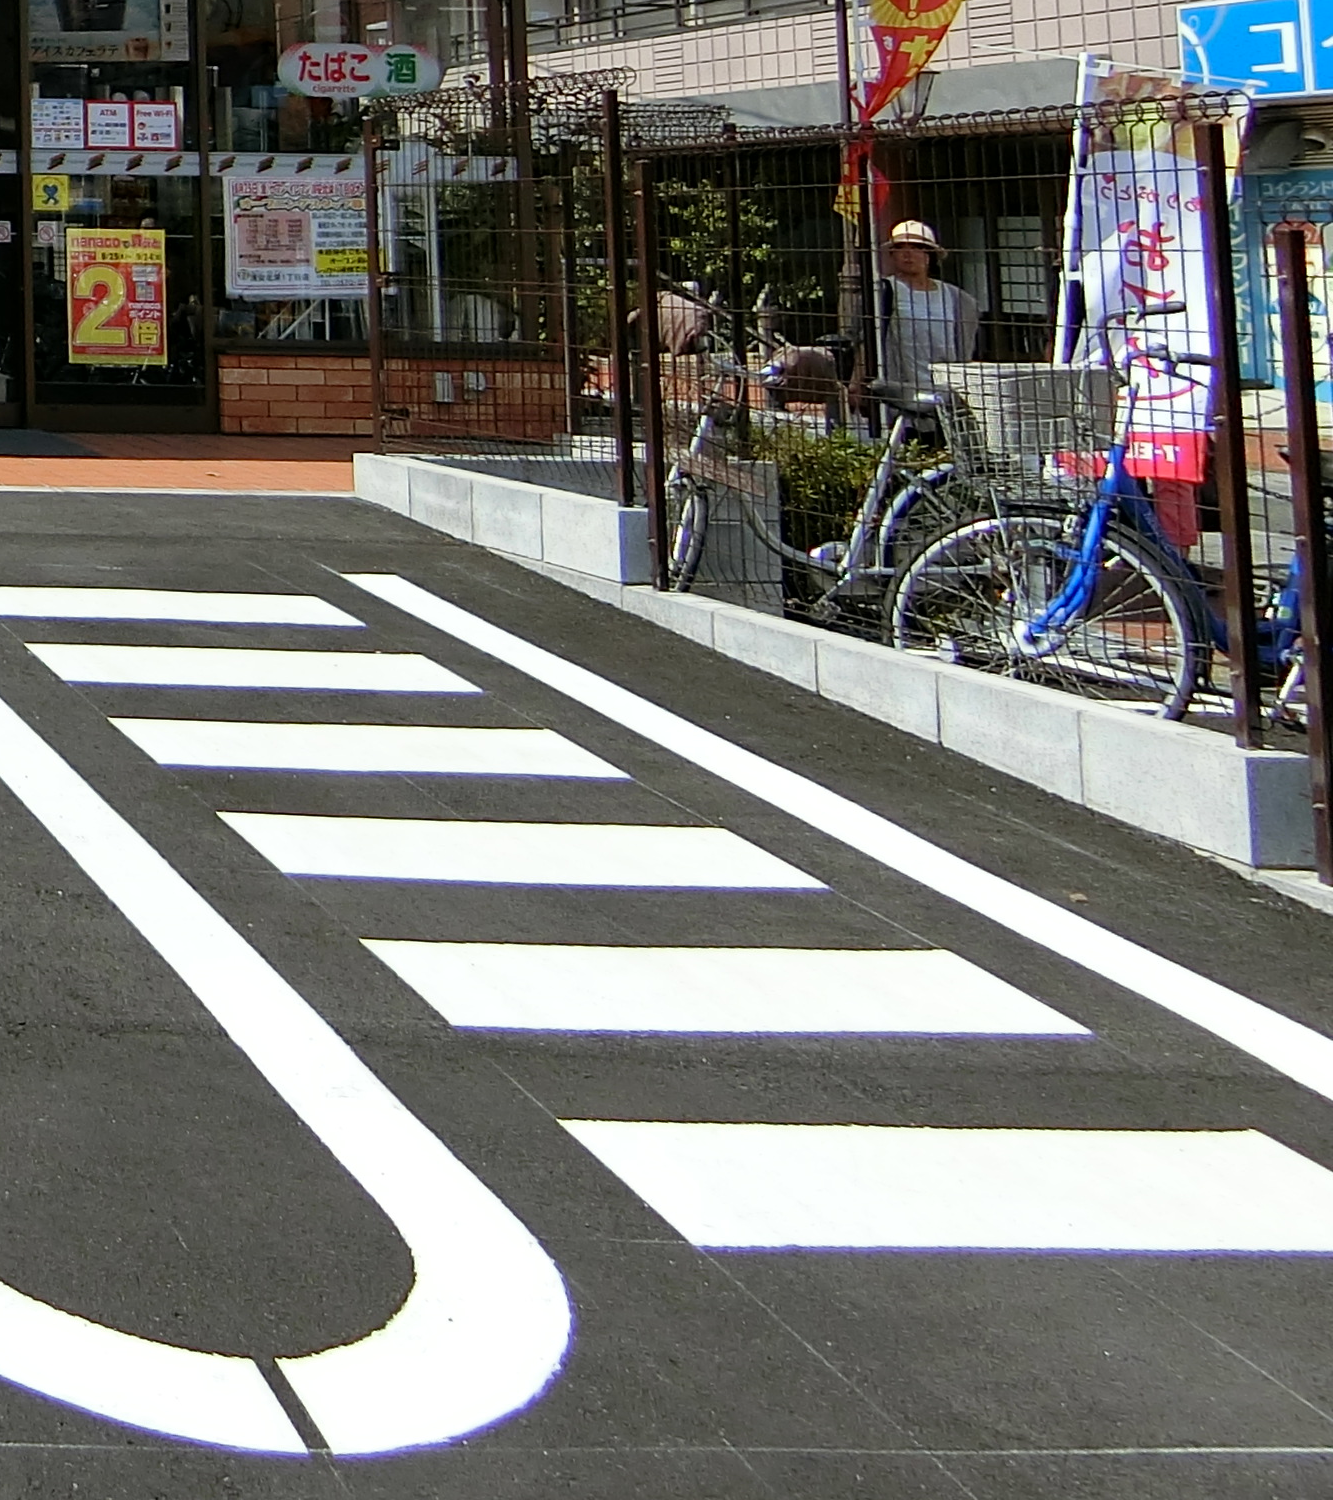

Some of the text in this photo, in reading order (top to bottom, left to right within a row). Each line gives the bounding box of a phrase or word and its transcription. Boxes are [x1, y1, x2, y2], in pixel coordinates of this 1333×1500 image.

[298, 51, 416, 83] たばこ 酒
[312, 85, 357, 94] cigarette
[99, 109, 117, 117] ATM
[136, 109, 152, 117] Free
[74, 265, 127, 346] 2
[129, 310, 161, 318] ポイント
